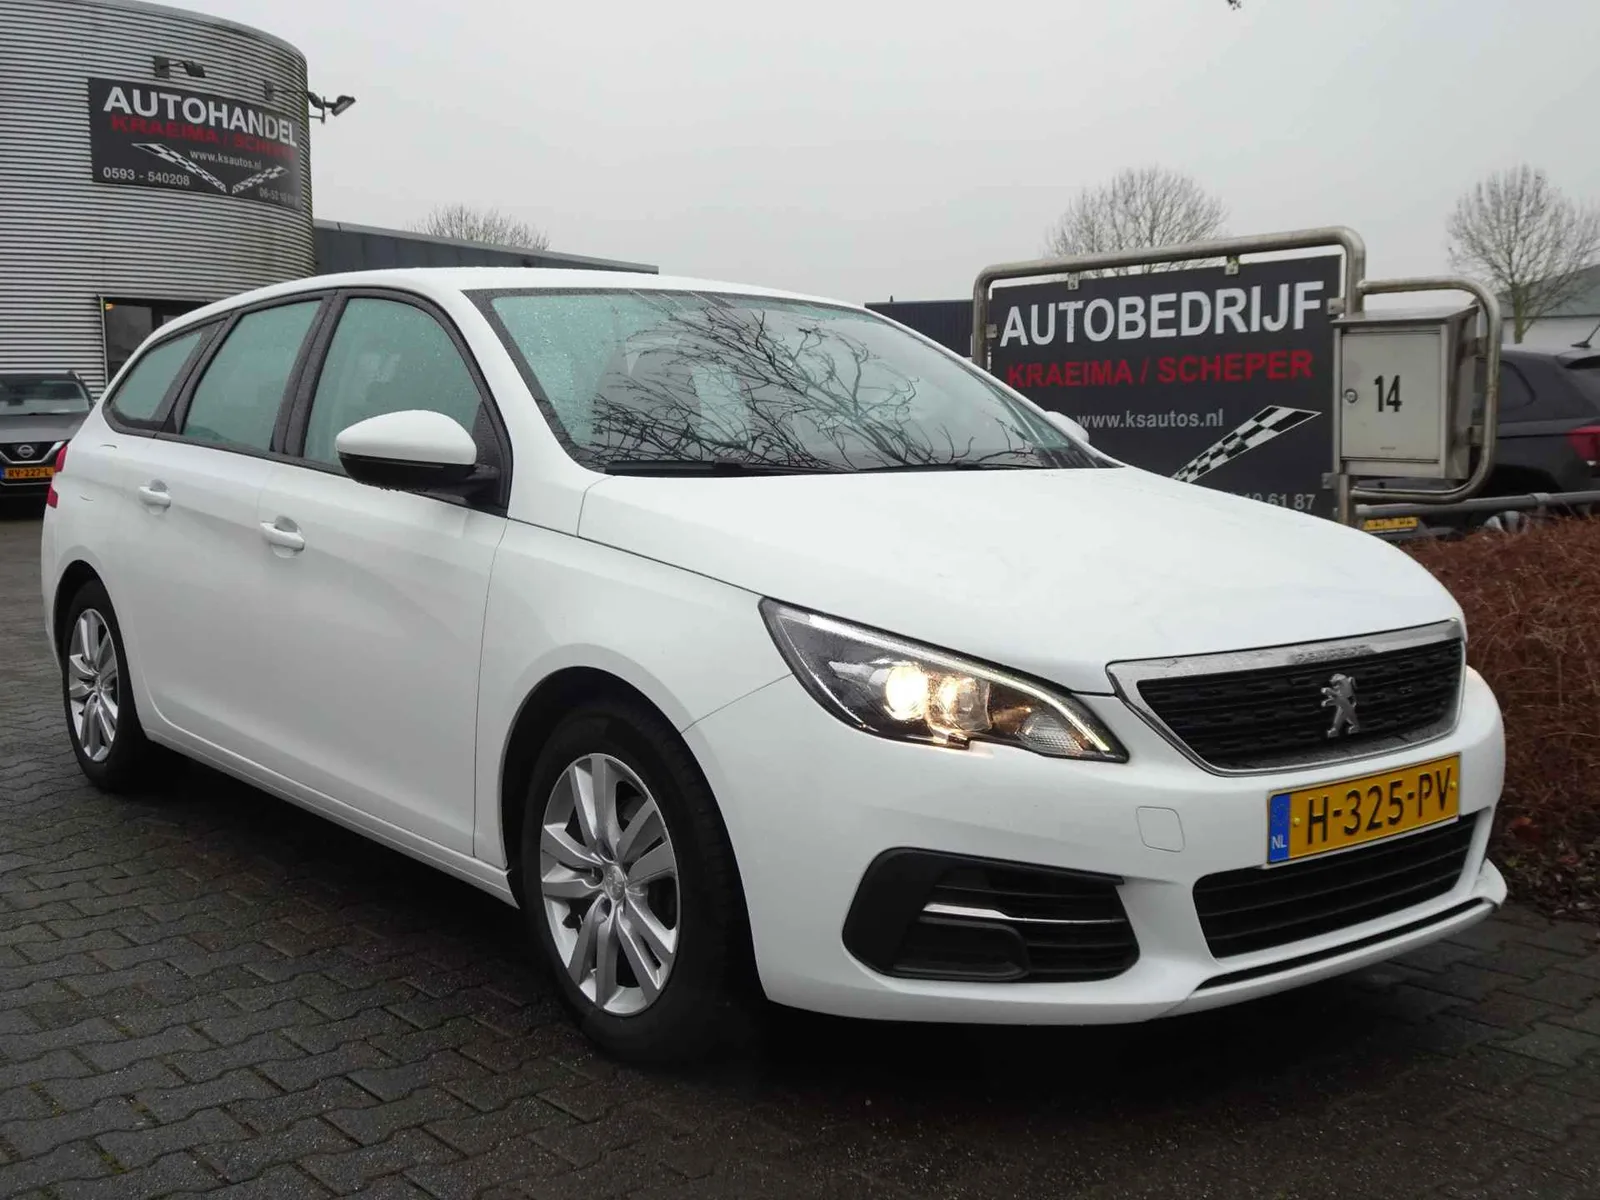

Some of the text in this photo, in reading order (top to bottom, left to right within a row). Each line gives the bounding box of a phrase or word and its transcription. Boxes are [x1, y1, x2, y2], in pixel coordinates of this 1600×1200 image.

[103, 86, 297, 147] AUTOHANDEL
[110, 114, 222, 145] KRAEIMA
[189, 149, 262, 170] www.ksautos.nl
[103, 166, 136, 181] 0593
[147, 170, 190, 187] 540208
[1000, 281, 1324, 347] AUTOBEDRIJF
[1007, 351, 1314, 388] KRAEIMA / SCHEPER
[1374, 375, 1402, 412] 14
[1077, 409, 1223, 429] www.ksautos.nl
[1267, 492, 1287, 507] 61
[1294, 493, 1316, 510] 87
[1307, 767, 1451, 844] H-325-PV
[1271, 834, 1287, 849] NL
